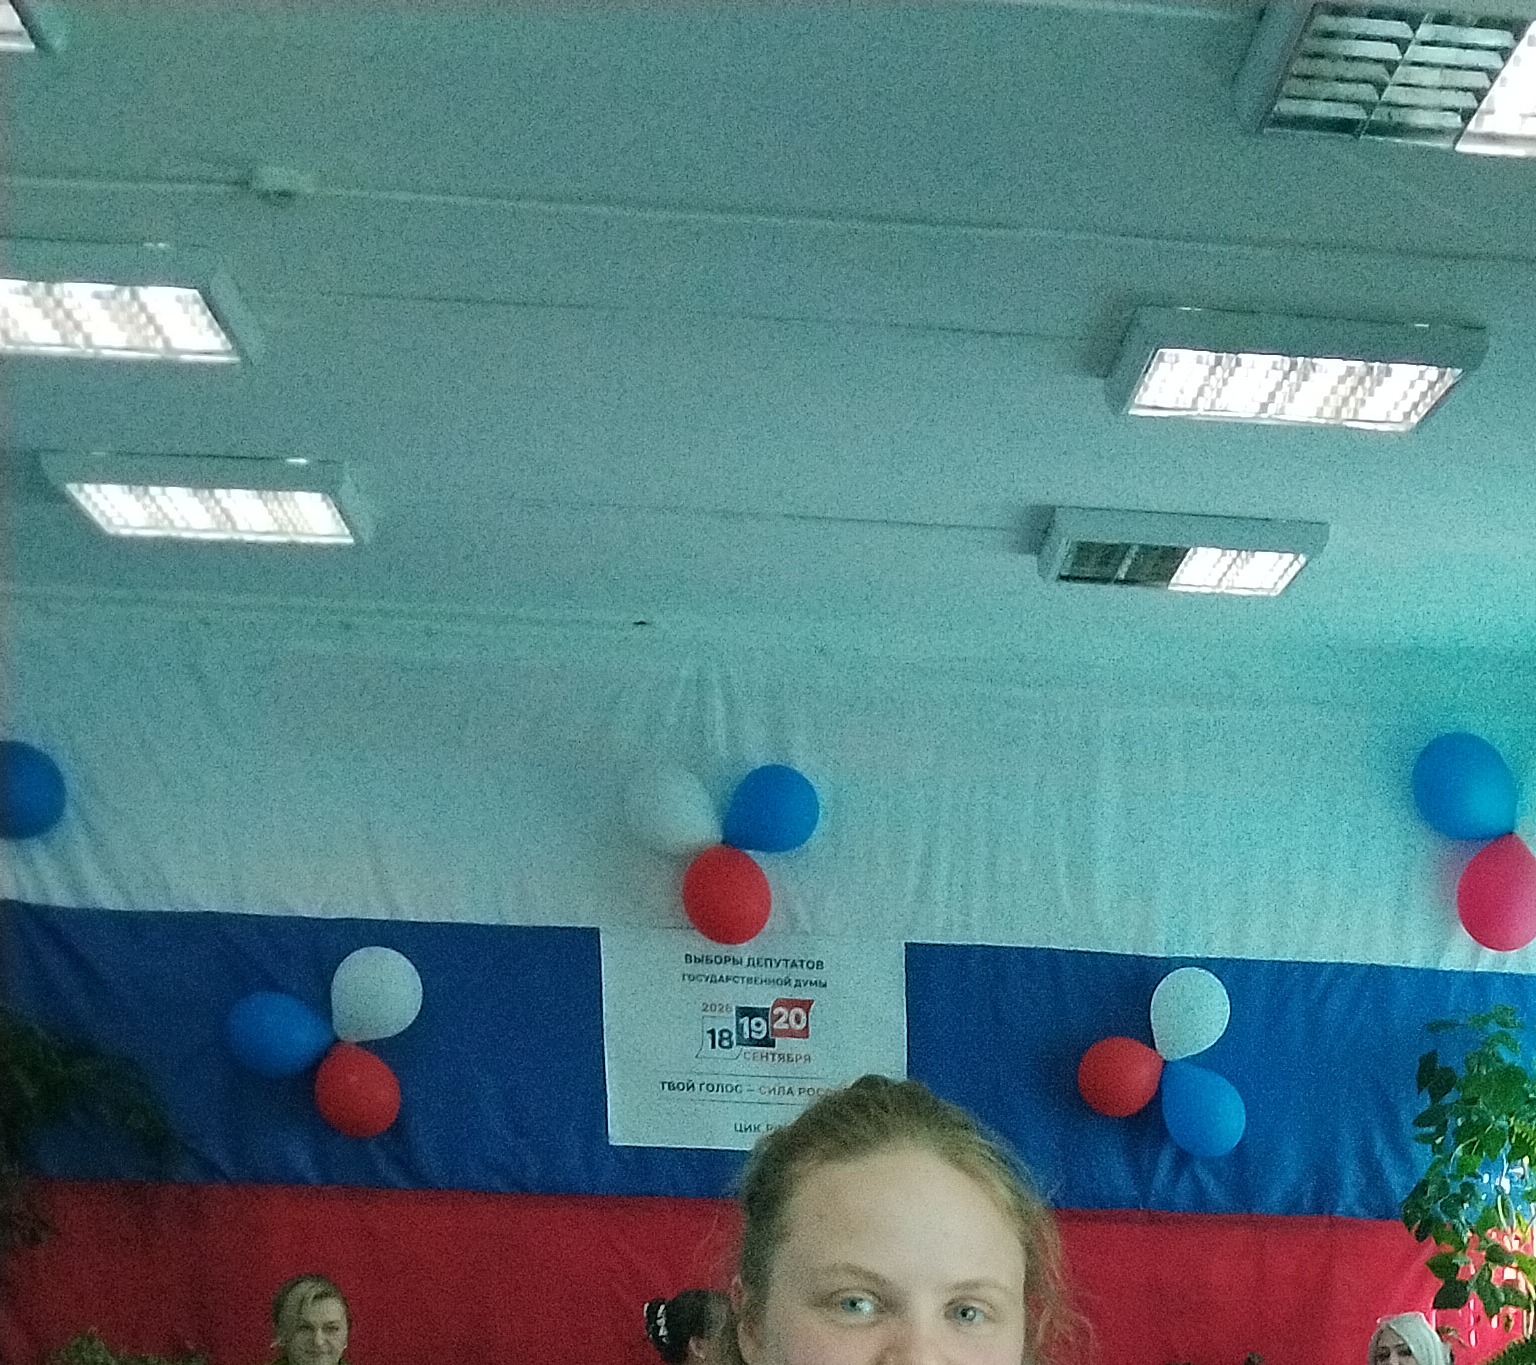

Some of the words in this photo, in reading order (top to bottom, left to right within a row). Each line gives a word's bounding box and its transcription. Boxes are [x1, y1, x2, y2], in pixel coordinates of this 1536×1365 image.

[684, 953, 743, 966] ВЫБОРЫ
[745, 957, 825, 970] ДЕПУТАТОВ
[681, 973, 792, 987] ГОСУДАРСТВЕННОЙ
[794, 979, 828, 988] ДУМЫ
[707, 1028, 733, 1049] 18
[738, 1016, 767, 1040] 19
[772, 1006, 807, 1030] 20
[743, 1051, 811, 1063] СЕНТЯБРЯ
[660, 1079, 695, 1092] ТВОЙ
[699, 1082, 743, 1093] ГОЛОС
[758, 1085, 795, 1096] СИЛА
[734, 1122, 761, 1133] ЦИК
